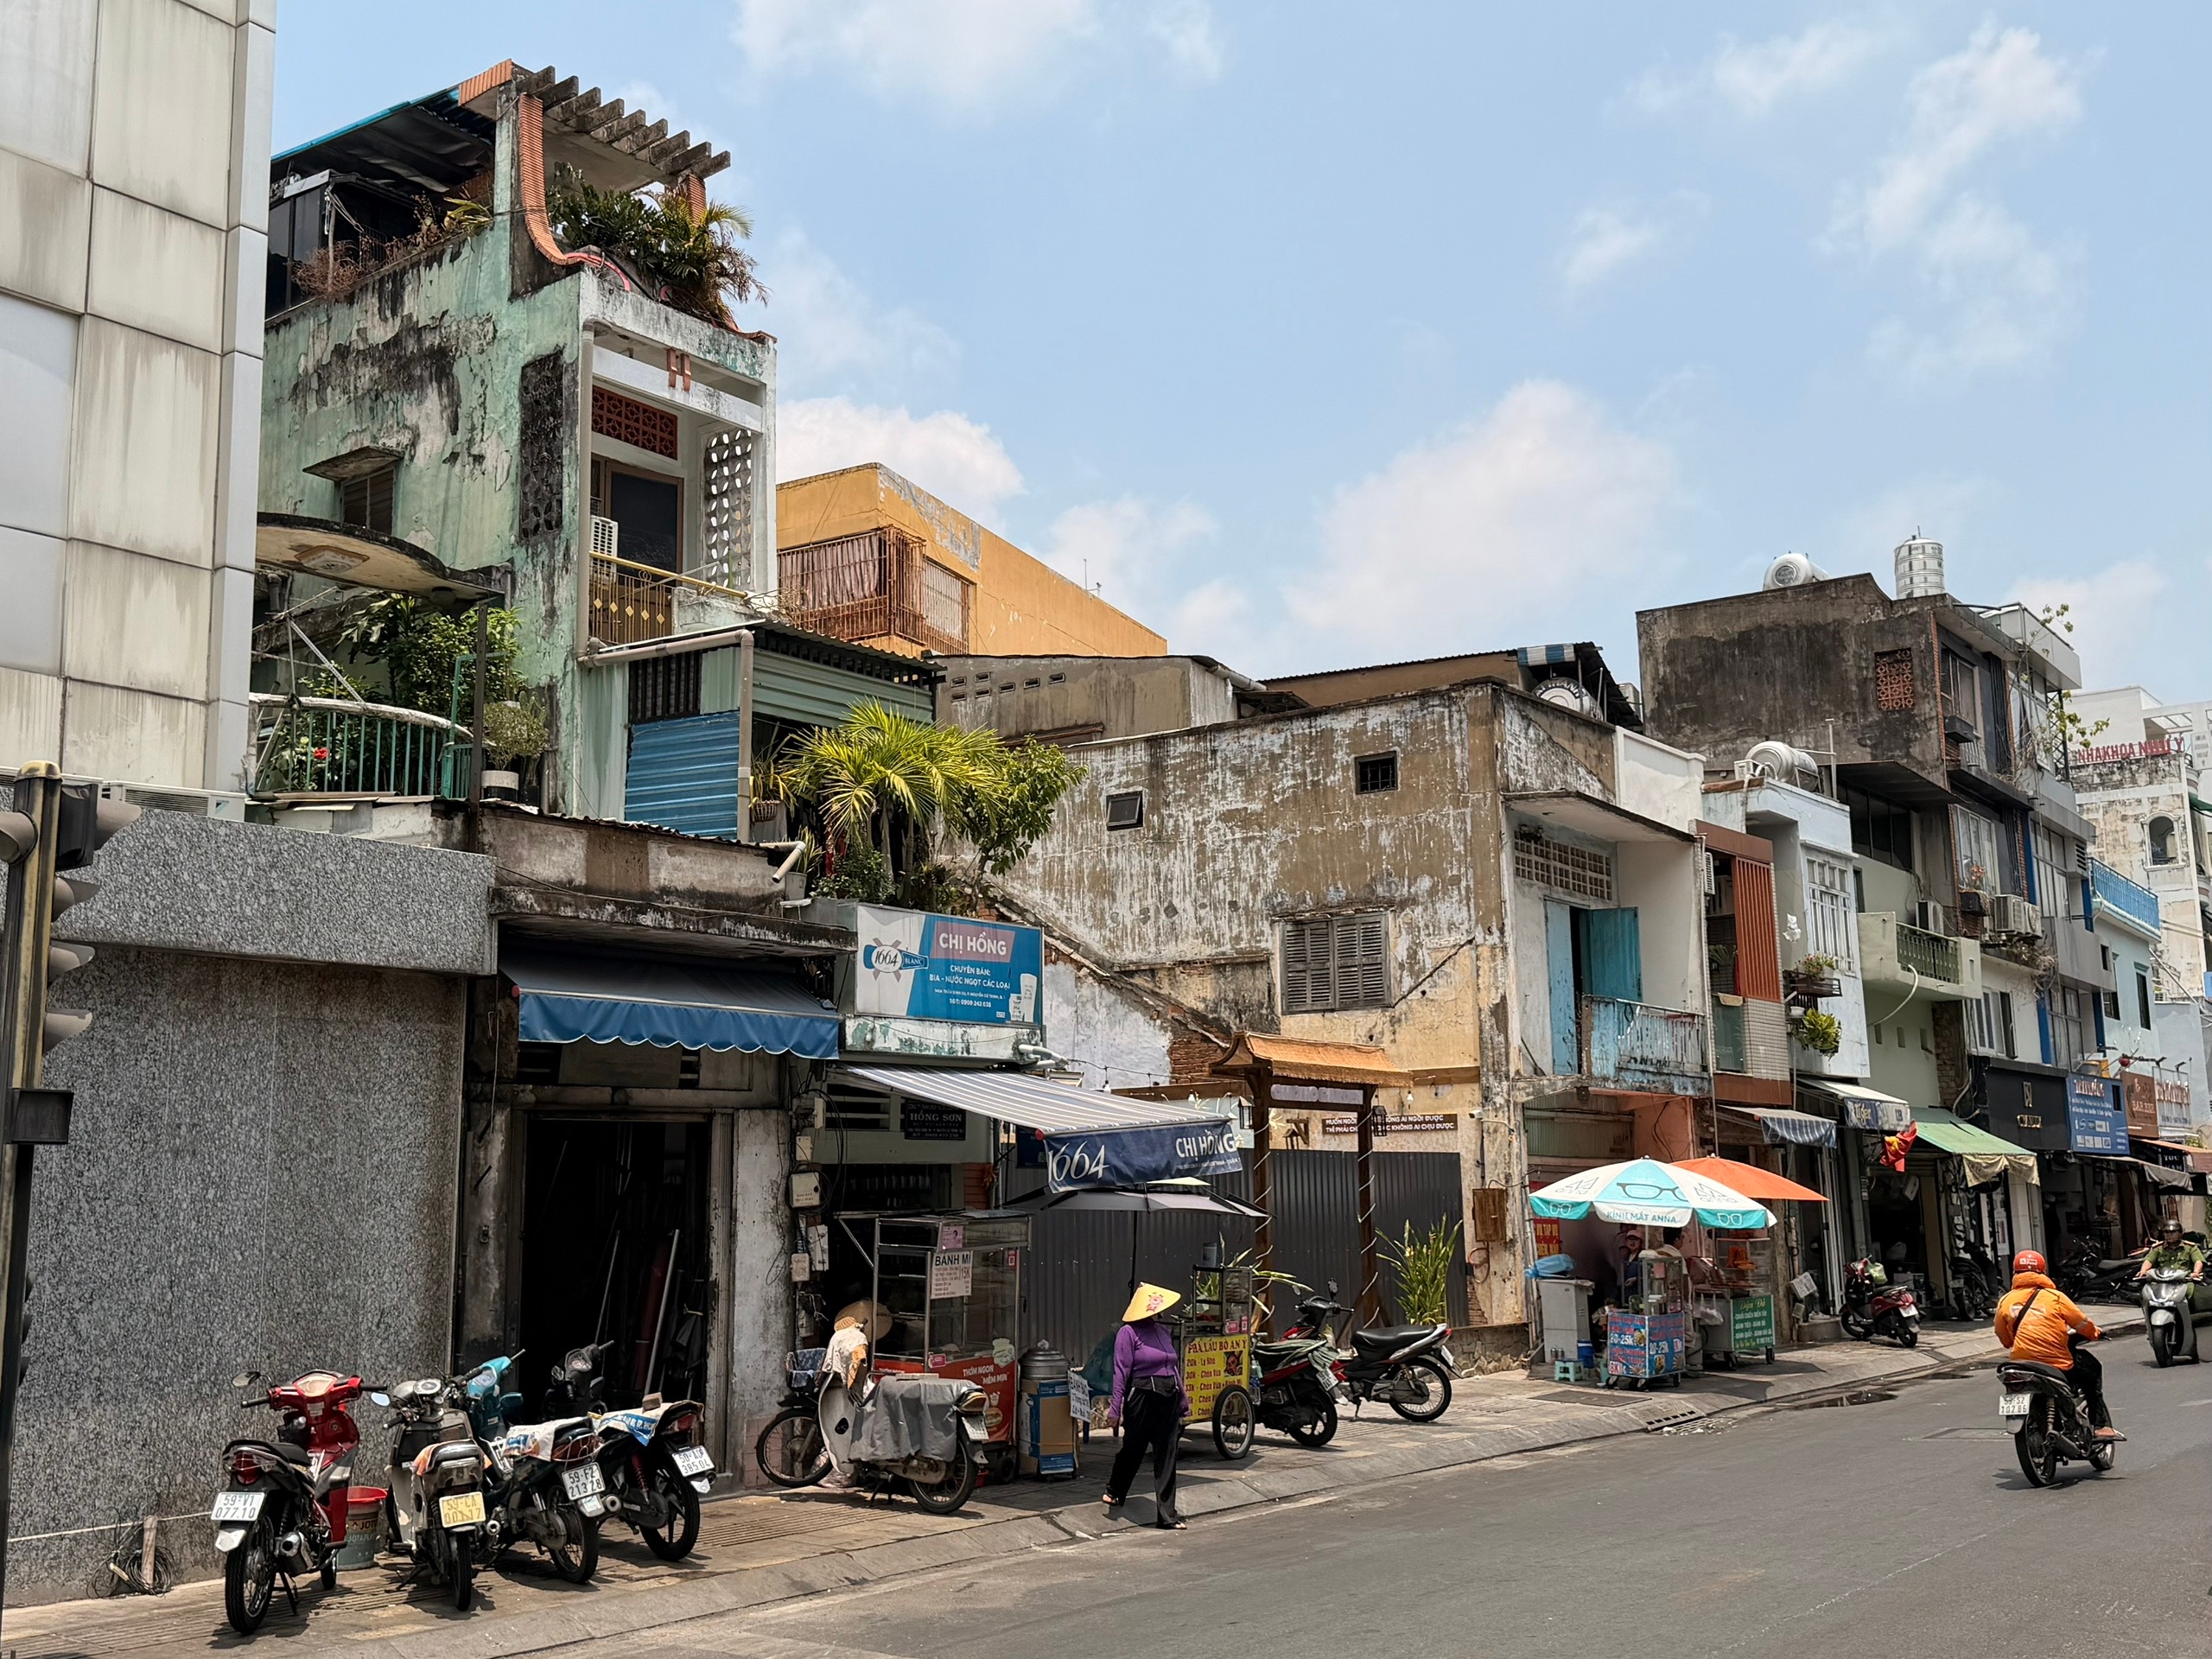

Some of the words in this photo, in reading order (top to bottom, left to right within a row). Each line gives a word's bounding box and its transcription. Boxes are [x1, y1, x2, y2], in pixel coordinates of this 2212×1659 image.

[938, 933, 963, 954] CHỊ
[967, 931, 1007, 956] HỒNG
[874, 950, 898, 966] 1664
[1048, 1141, 1109, 1182] 1664
[1176, 1137, 1198, 1161] CHỊ
[1198, 1129, 1237, 1155] HỒNG
[1651, 1215, 1677, 1224] ANNA
[223, 1494, 255, 1506] 59-V1
[215, 1507, 257, 1519] 077.10
